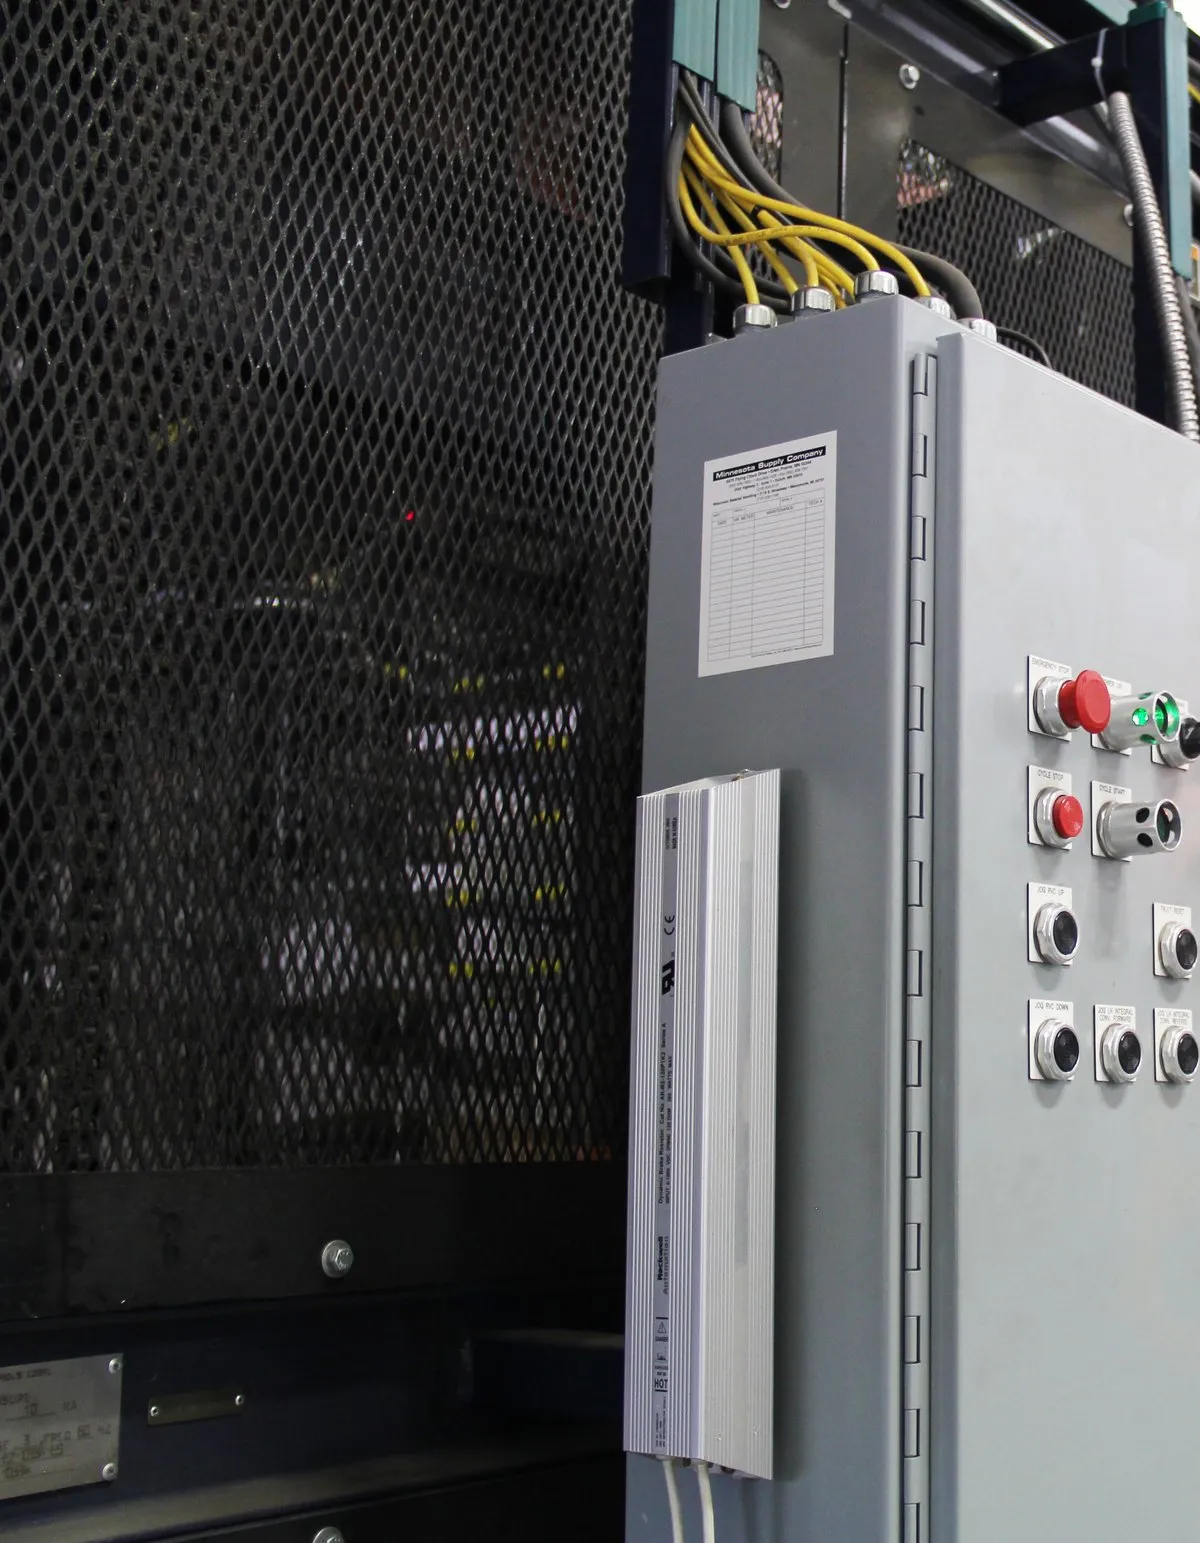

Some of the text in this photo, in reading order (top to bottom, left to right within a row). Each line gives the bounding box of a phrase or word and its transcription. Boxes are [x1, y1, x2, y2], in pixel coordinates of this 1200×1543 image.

[715, 448, 824, 479] Minnesota Supply Company
[1032, 657, 1070, 674] EMERGENCY STOP
[1037, 769, 1064, 781] CYCLE STOP
[1099, 785, 1126, 795] CYCLE START
[1056, 1003, 1069, 1011] DOWN
[654, 1378, 668, 1389] HOT
